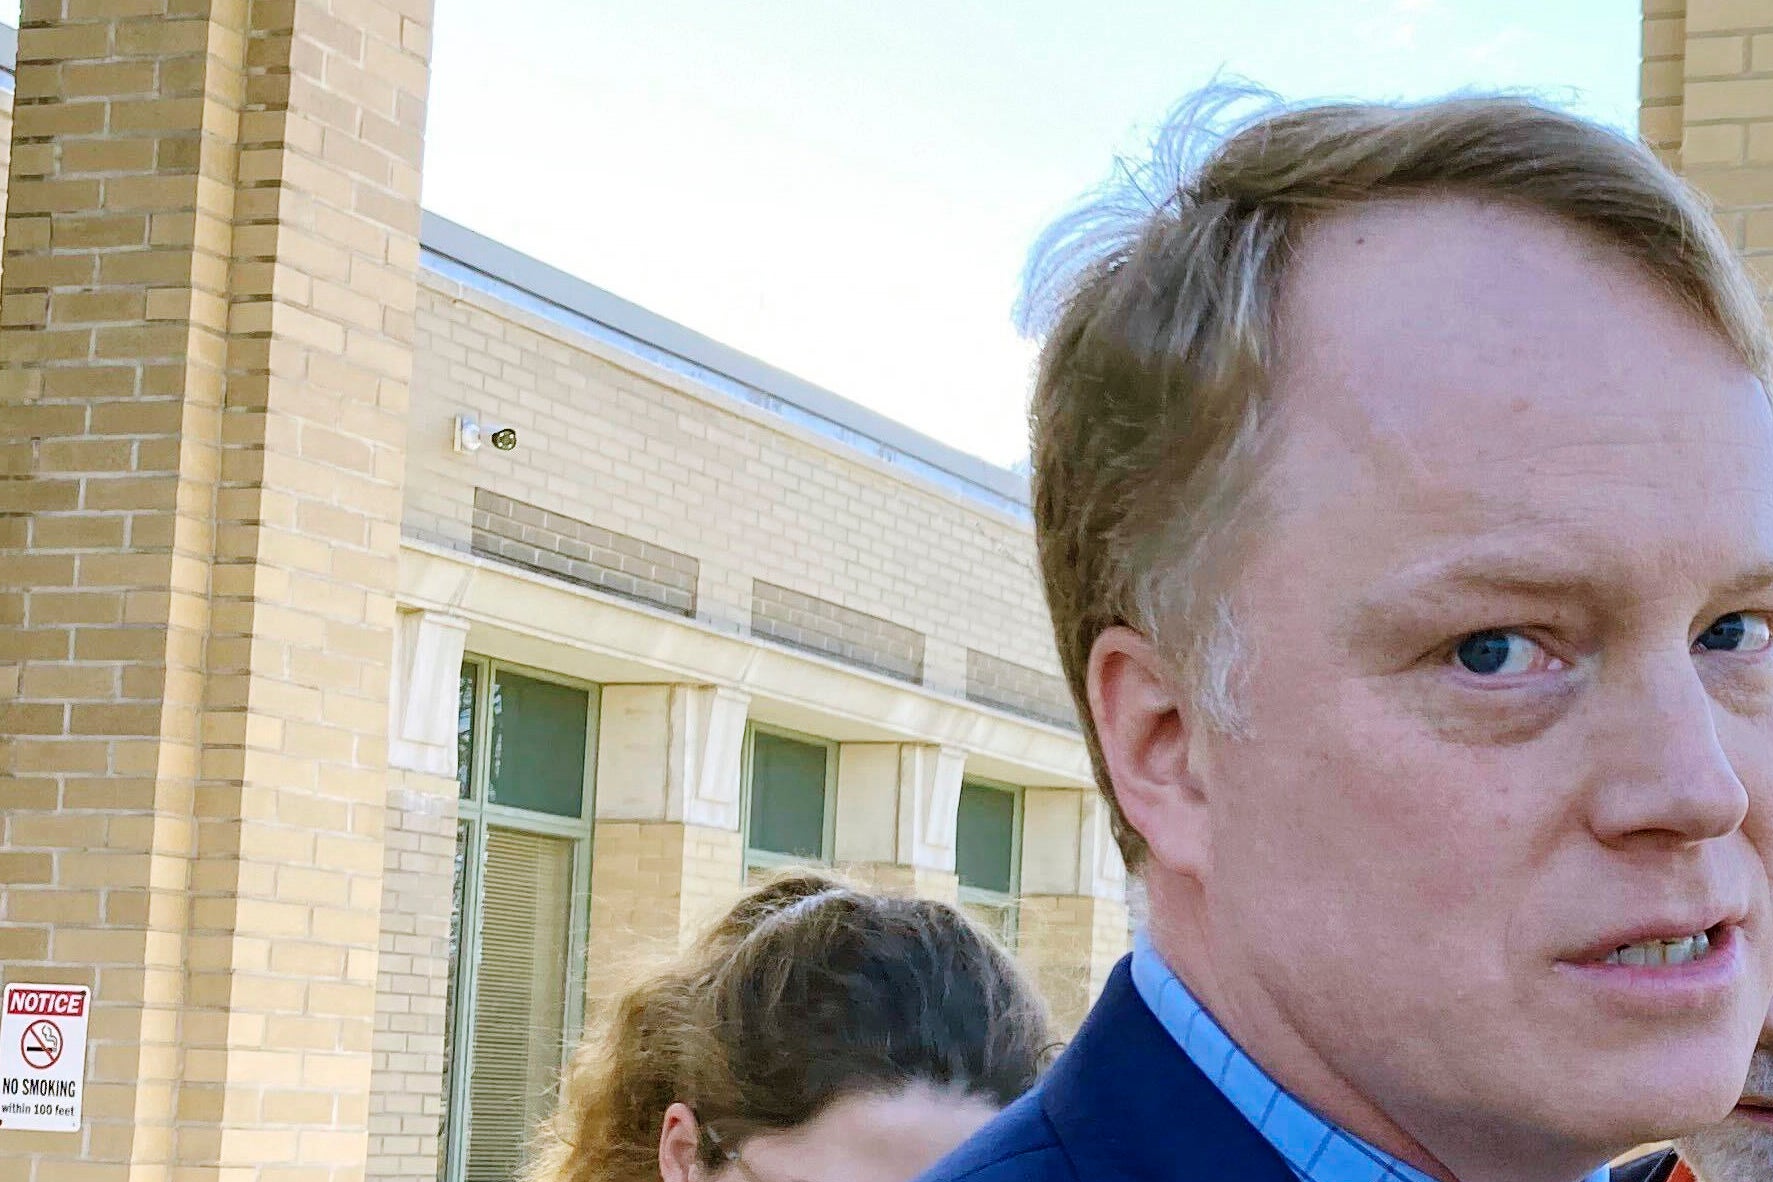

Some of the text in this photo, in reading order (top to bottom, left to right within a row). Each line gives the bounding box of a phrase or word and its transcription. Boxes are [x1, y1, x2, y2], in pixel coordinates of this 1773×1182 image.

[10, 991, 82, 1014] NOTICE
[2, 1077, 76, 1098] NO SMOKING
[1, 1103, 31, 1115] within
[55, 1104, 75, 1116] feet
